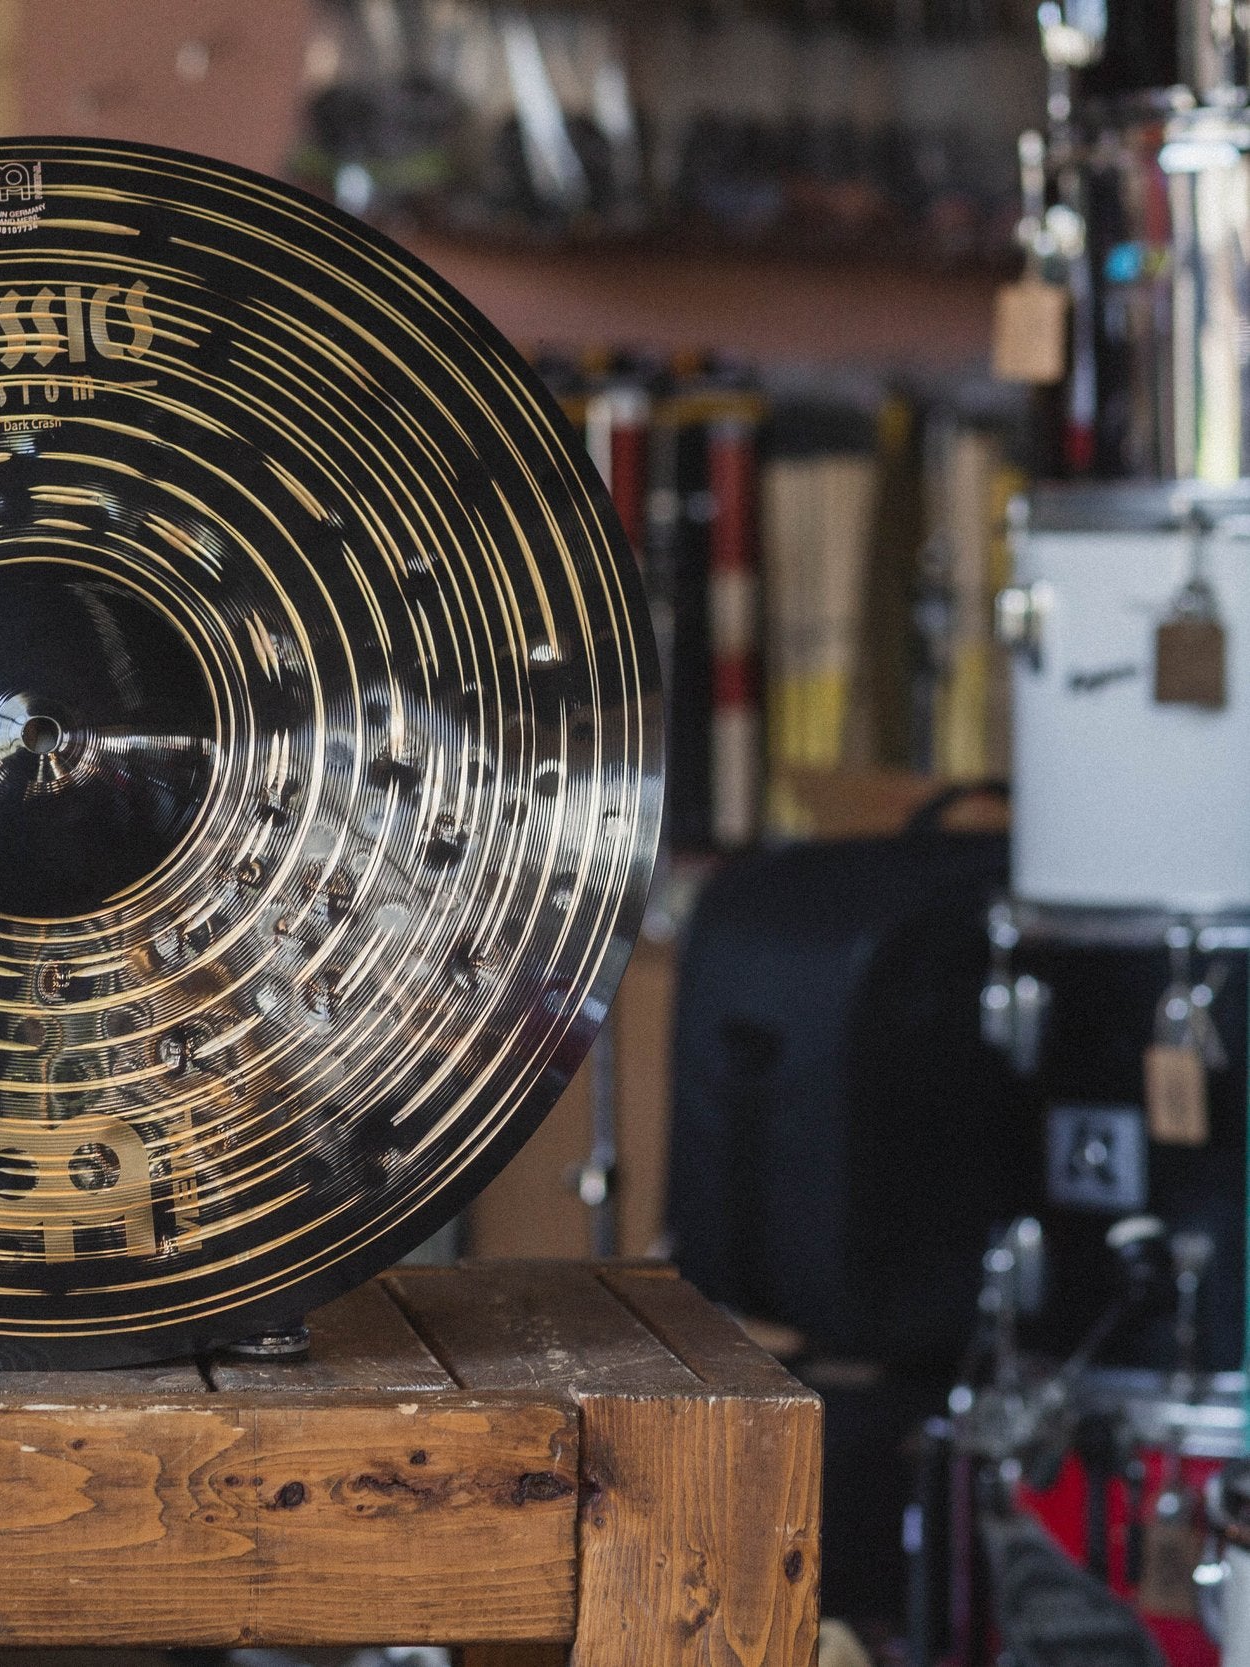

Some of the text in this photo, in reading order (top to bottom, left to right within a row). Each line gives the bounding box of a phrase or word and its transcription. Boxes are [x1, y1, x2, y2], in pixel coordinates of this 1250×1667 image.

[0, 210, 8, 218] IN
[9, 203, 46, 217] GERMANY
[4, 419, 30, 432] Dark
[31, 418, 62, 430] Crash
